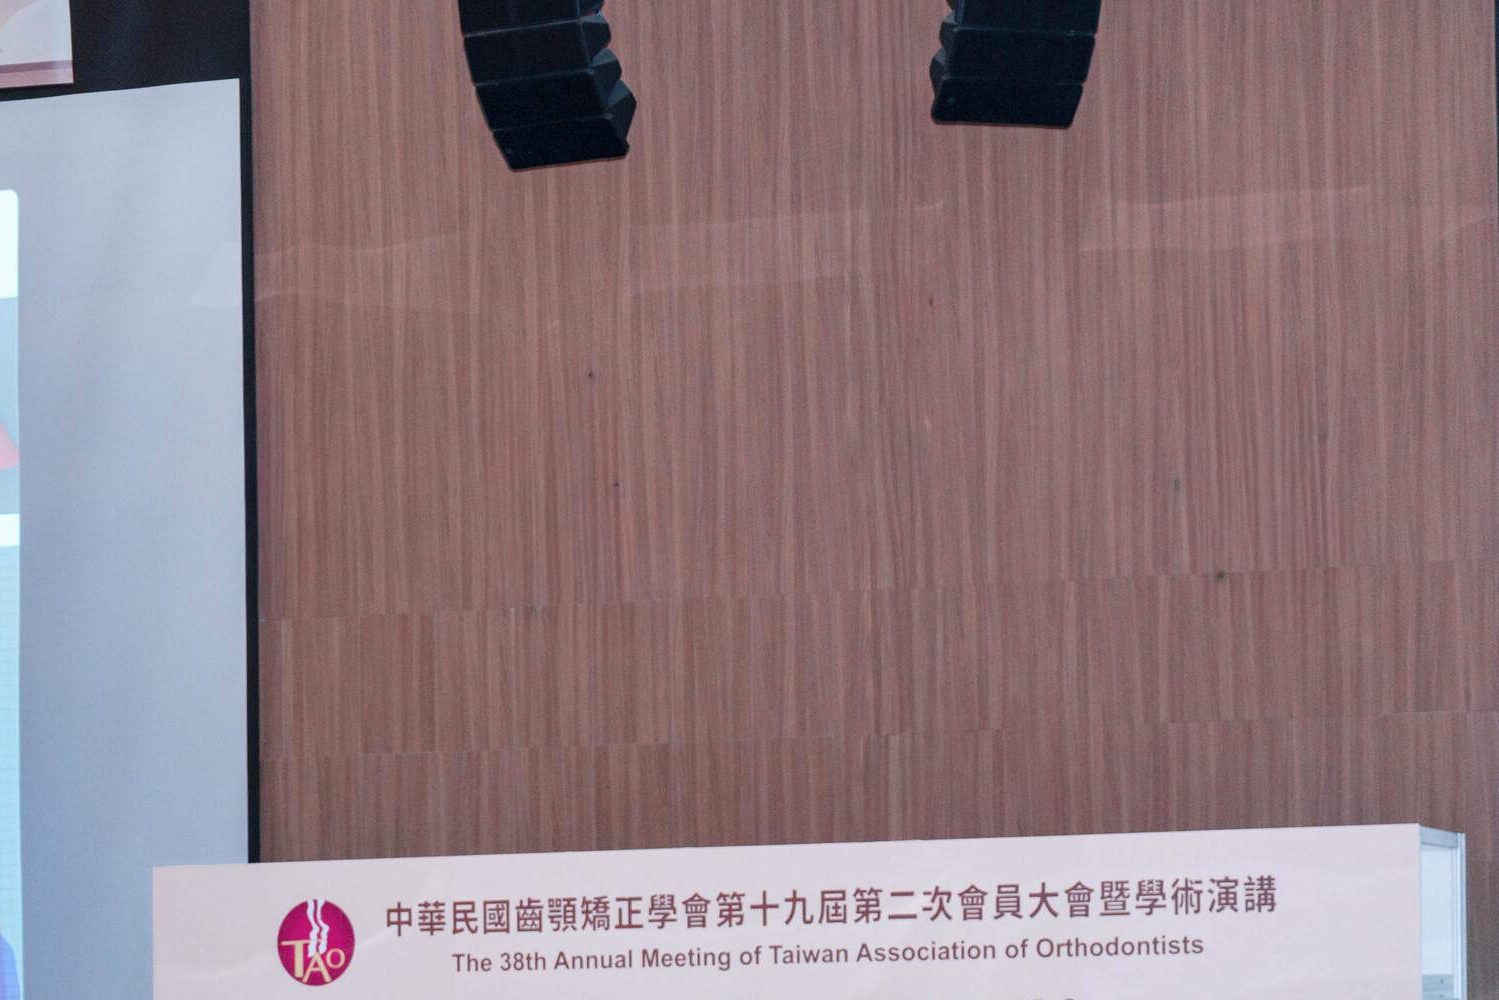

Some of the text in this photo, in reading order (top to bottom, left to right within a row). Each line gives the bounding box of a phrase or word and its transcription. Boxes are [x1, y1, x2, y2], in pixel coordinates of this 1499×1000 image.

[386, 875, 1277, 936] 中華民國齒顎矯正學會第十九屆第二次會員大會暨學術演講
[280, 938, 346, 984] TAO
[452, 936, 1203, 972] The 38th Annual Meeting of Taiwan Association of Orthodontists
